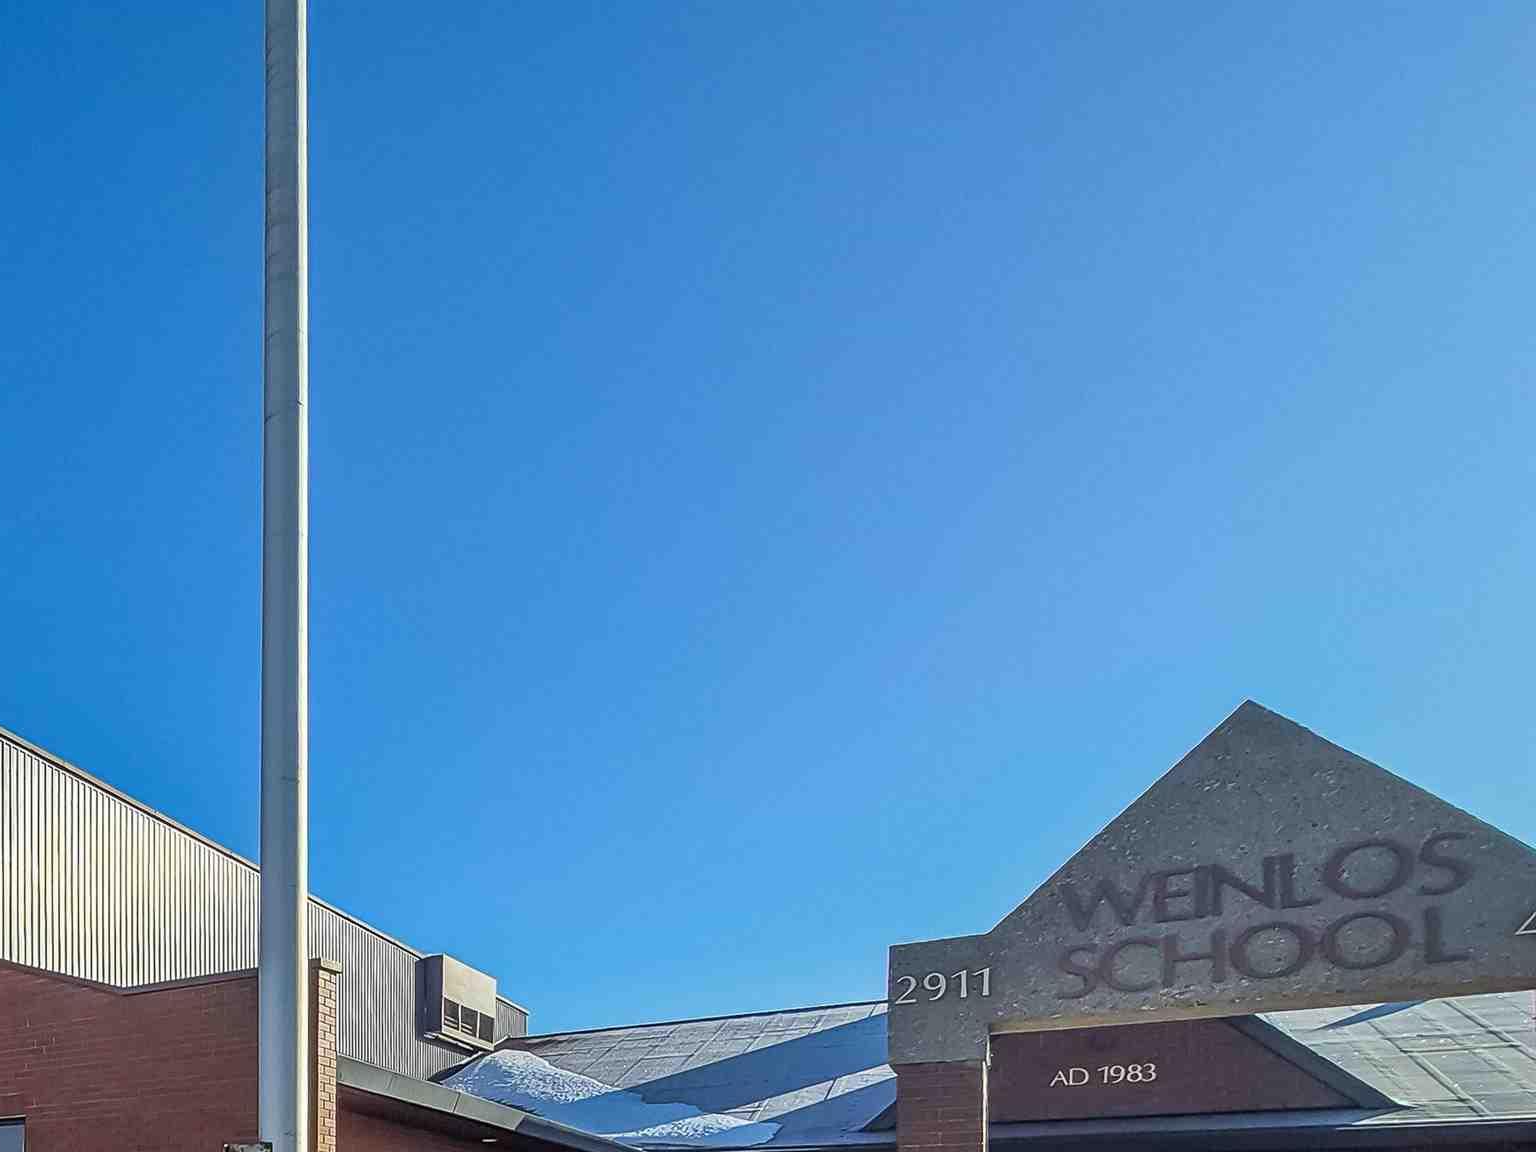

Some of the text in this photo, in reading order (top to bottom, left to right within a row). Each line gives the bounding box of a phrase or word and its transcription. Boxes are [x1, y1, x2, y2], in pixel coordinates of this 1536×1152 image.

[1061, 832, 1474, 932] WEINLOS
[895, 967, 991, 1005] 2911
[1058, 905, 1474, 1001] SCHOOL
[1050, 1063, 1157, 1087] AD 1983
